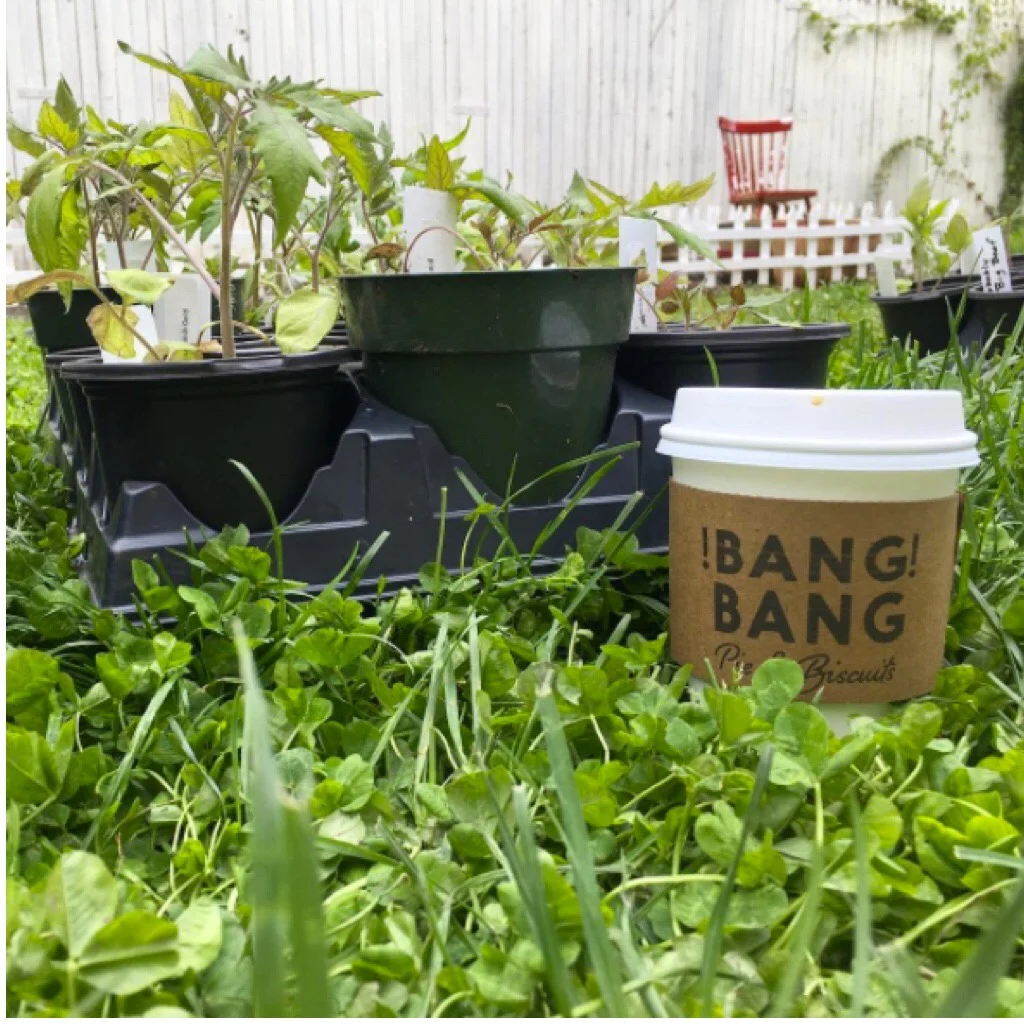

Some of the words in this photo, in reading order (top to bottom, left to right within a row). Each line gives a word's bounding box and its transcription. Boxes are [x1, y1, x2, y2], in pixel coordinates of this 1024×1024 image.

[702, 526, 920, 583] !BANG!
[713, 582, 906, 646] BANG
[798, 654, 897, 696] Biscuits
